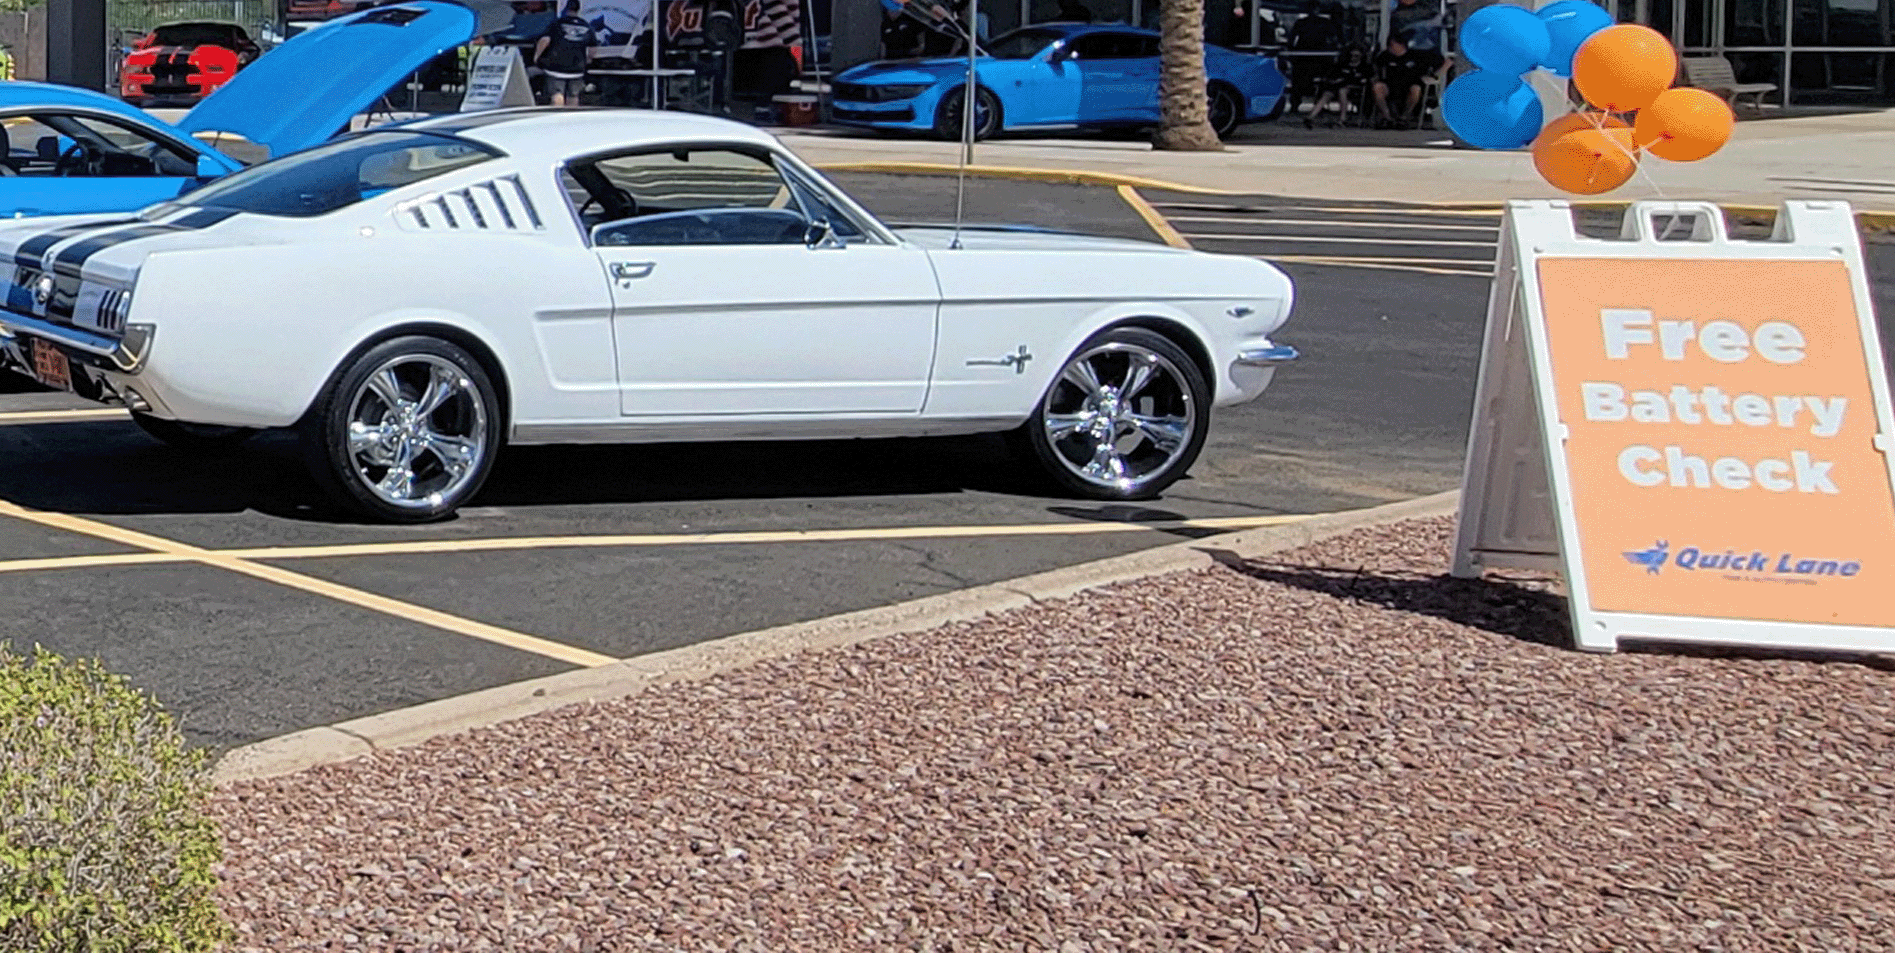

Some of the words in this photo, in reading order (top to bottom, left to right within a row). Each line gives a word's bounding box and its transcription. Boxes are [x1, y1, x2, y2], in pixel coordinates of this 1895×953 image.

[1599, 307, 1807, 364] Free
[1580, 381, 1848, 437] Battery
[1617, 445, 1841, 494] Check
[1674, 547, 1770, 572] Quick
[1773, 553, 1862, 578] Lane
